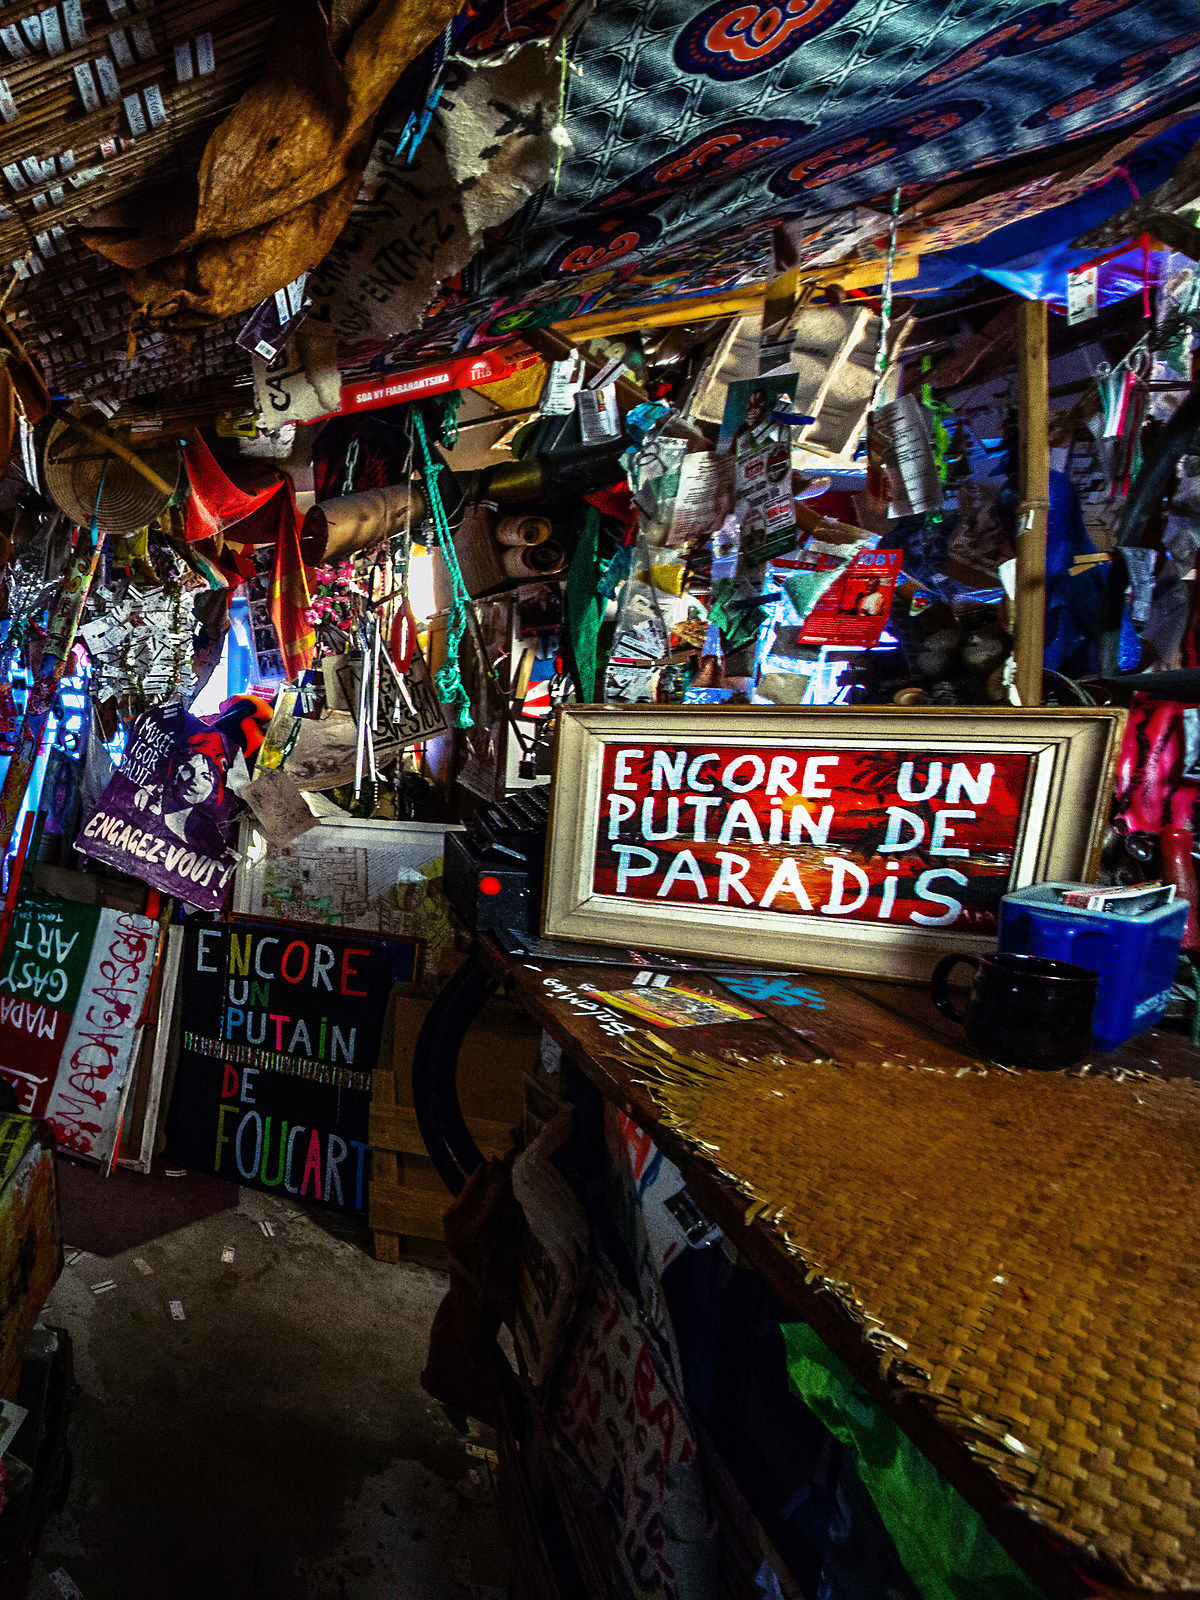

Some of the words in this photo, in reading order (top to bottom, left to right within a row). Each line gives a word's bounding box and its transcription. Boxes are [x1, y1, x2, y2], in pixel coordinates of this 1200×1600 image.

[615, 748, 840, 798] ENCORE
[898, 760, 995, 805] UN
[877, 809, 978, 857] DE
[15, 922, 80, 963] ART
[196, 929, 372, 998] ENCORE
[227, 979, 271, 1007] UN
[221, 1062, 261, 1103] DE
[213, 1105, 372, 1210] FOUCART
